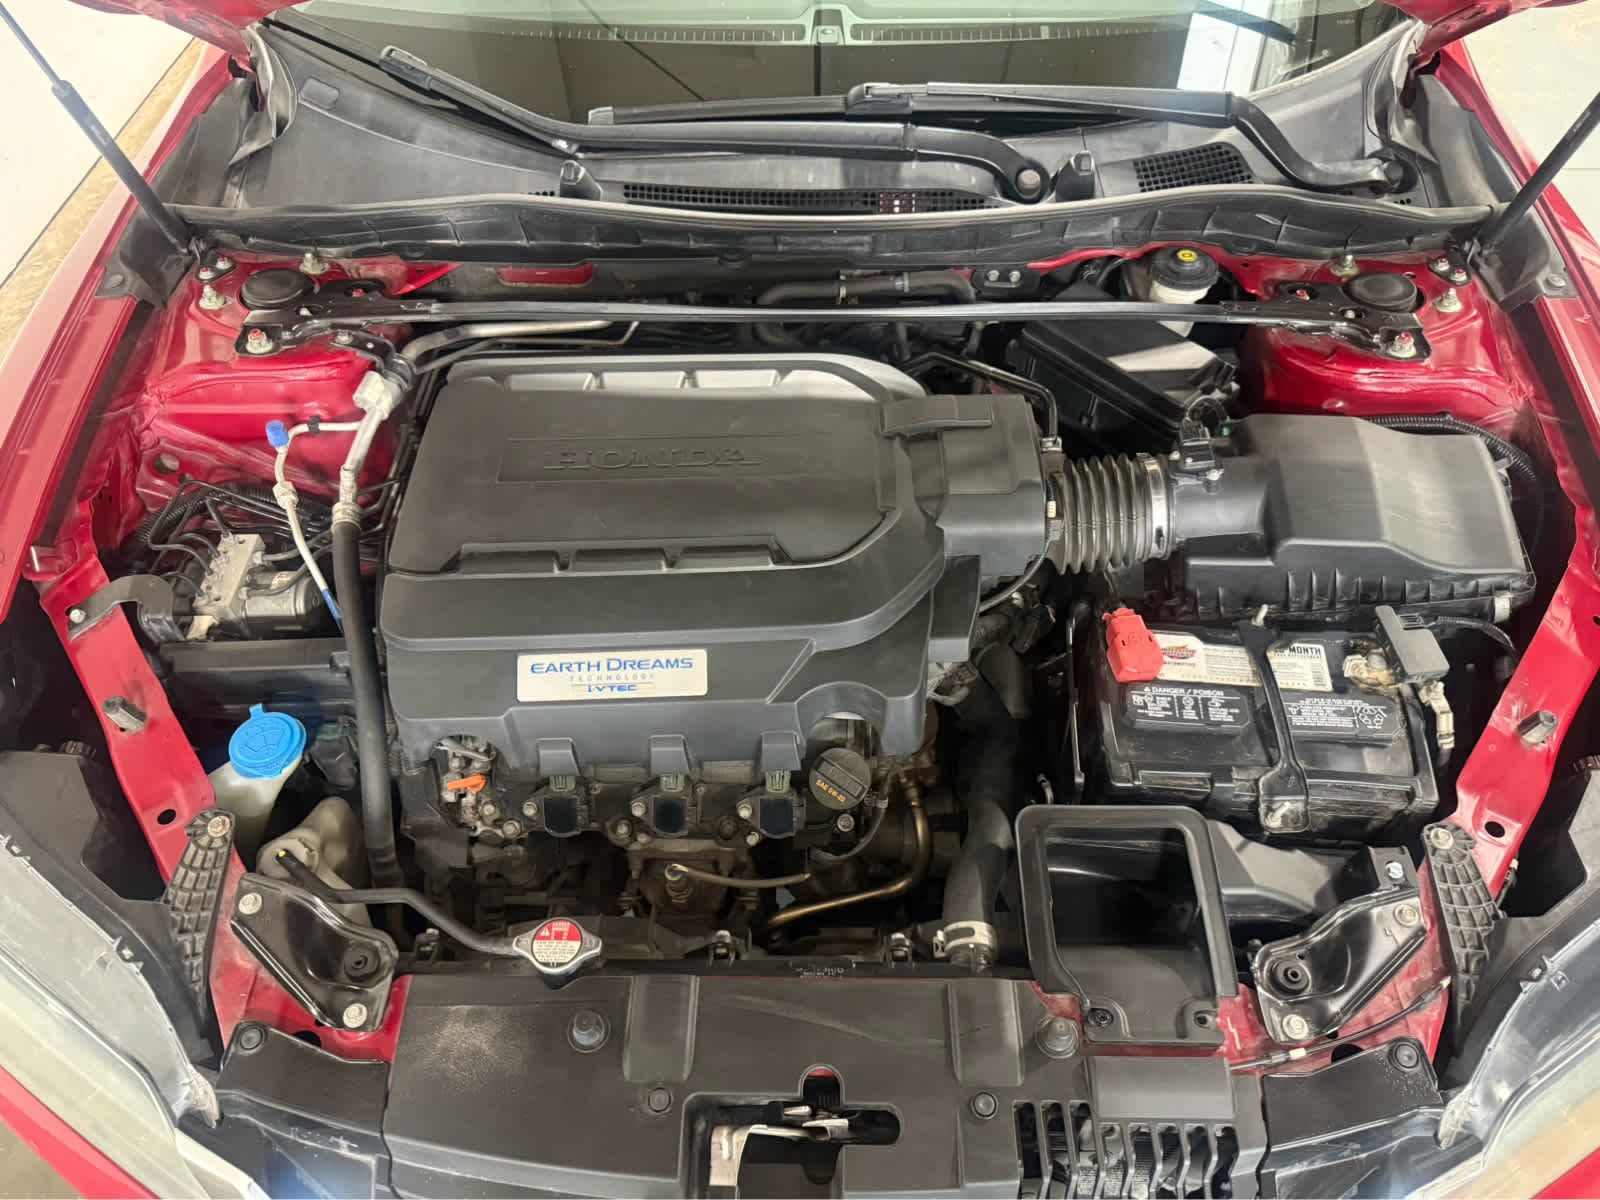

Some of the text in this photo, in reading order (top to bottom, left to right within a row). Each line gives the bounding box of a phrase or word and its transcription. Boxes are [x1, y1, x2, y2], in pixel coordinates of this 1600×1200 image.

[543, 449, 760, 470] HONDA
[1289, 646, 1321, 656] MONTH
[530, 657, 694, 674] EARTH DREAMS
[570, 673, 654, 682] TECHNOLOGY
[1152, 687, 1185, 695] DANGER
[1193, 689, 1224, 697] POISON
